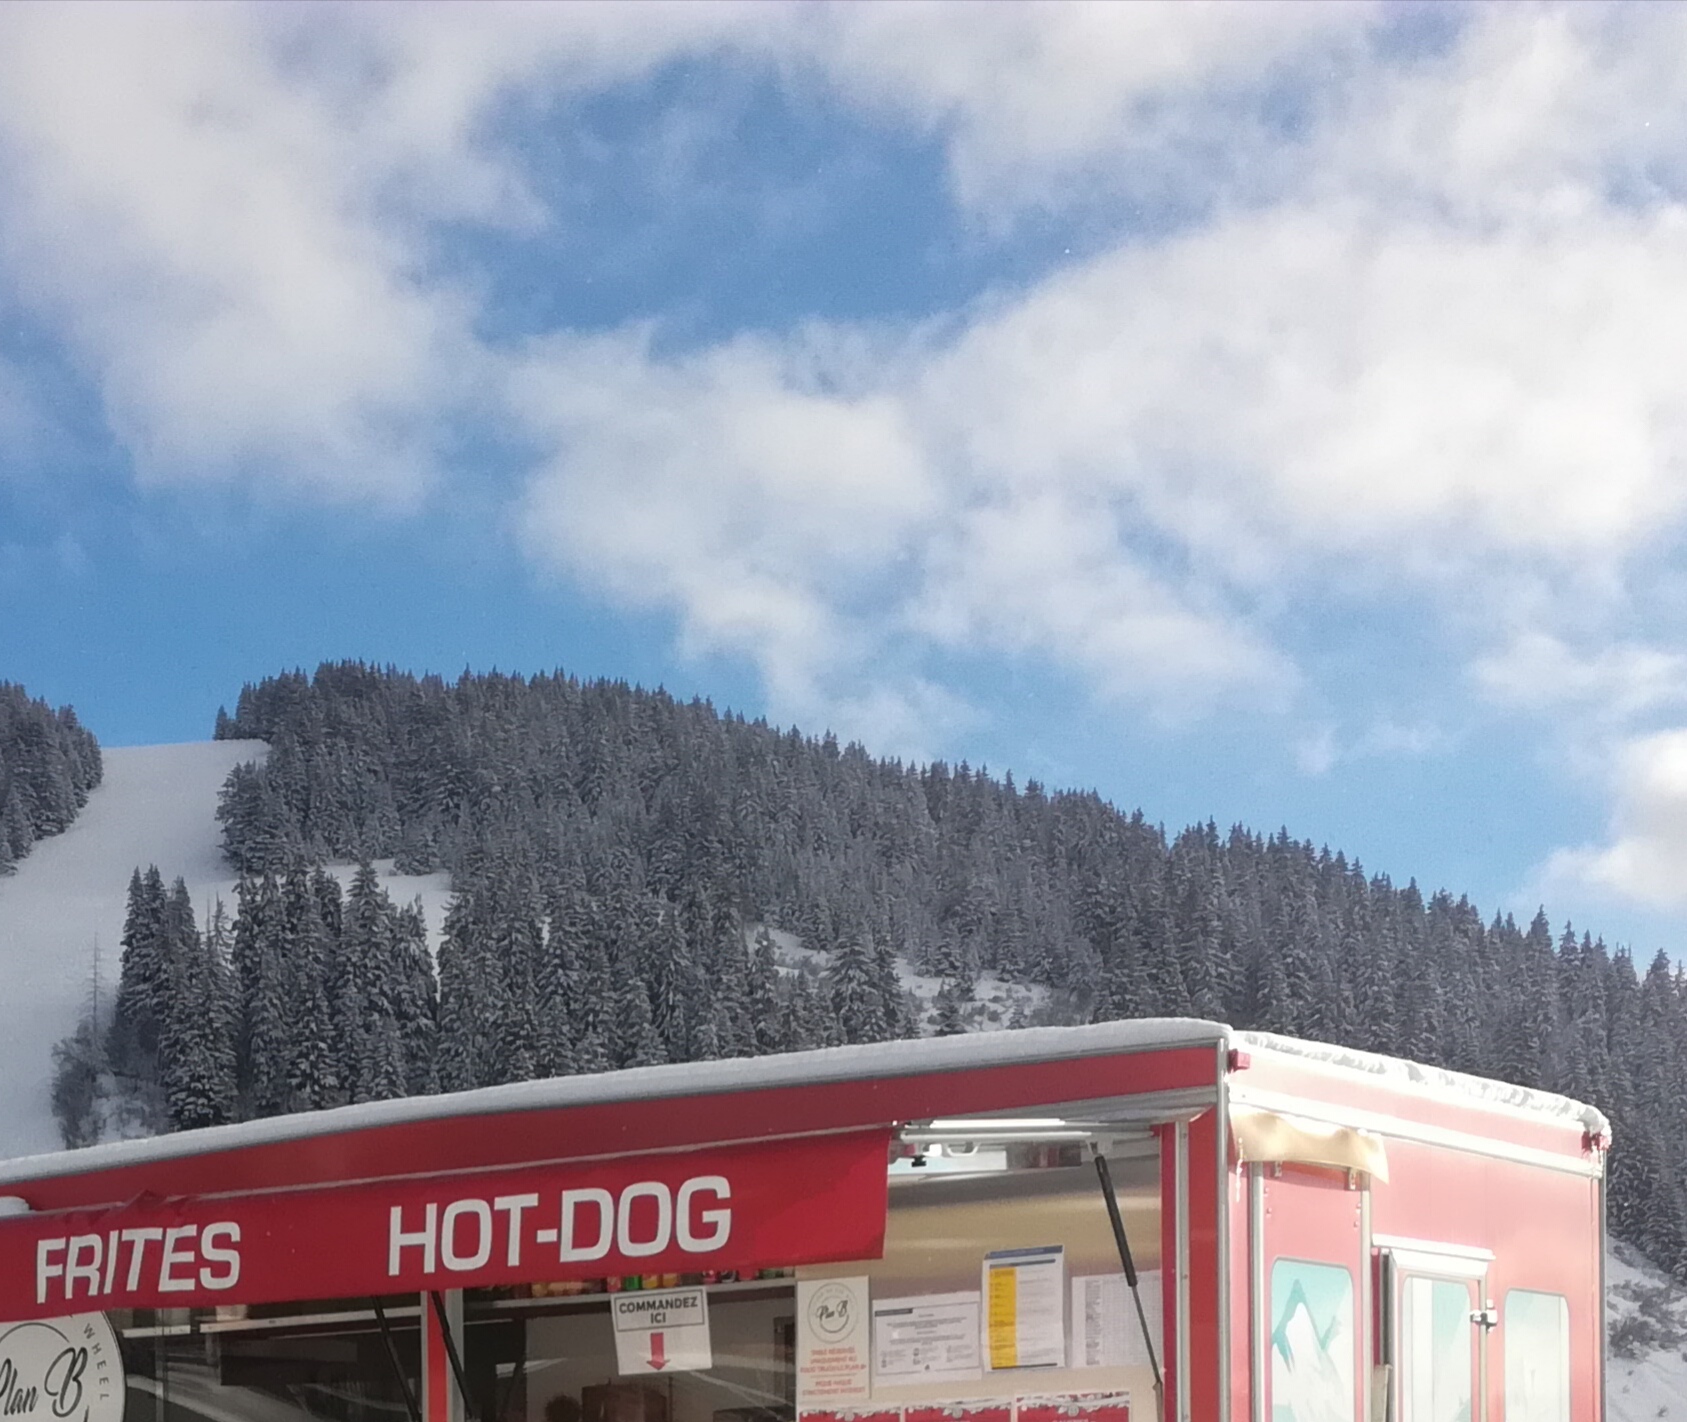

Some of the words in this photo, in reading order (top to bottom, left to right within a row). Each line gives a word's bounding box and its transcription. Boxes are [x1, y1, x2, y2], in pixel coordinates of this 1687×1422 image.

[37, 1222, 241, 1303] FRITES
[388, 1175, 732, 1276] HOT-DOG
[618, 1296, 699, 1314] COMMANDEZ
[650, 1312, 667, 1324] ICI
[44, 1346, 88, 1418] B
[83, 1323, 110, 1401] WHEEL
